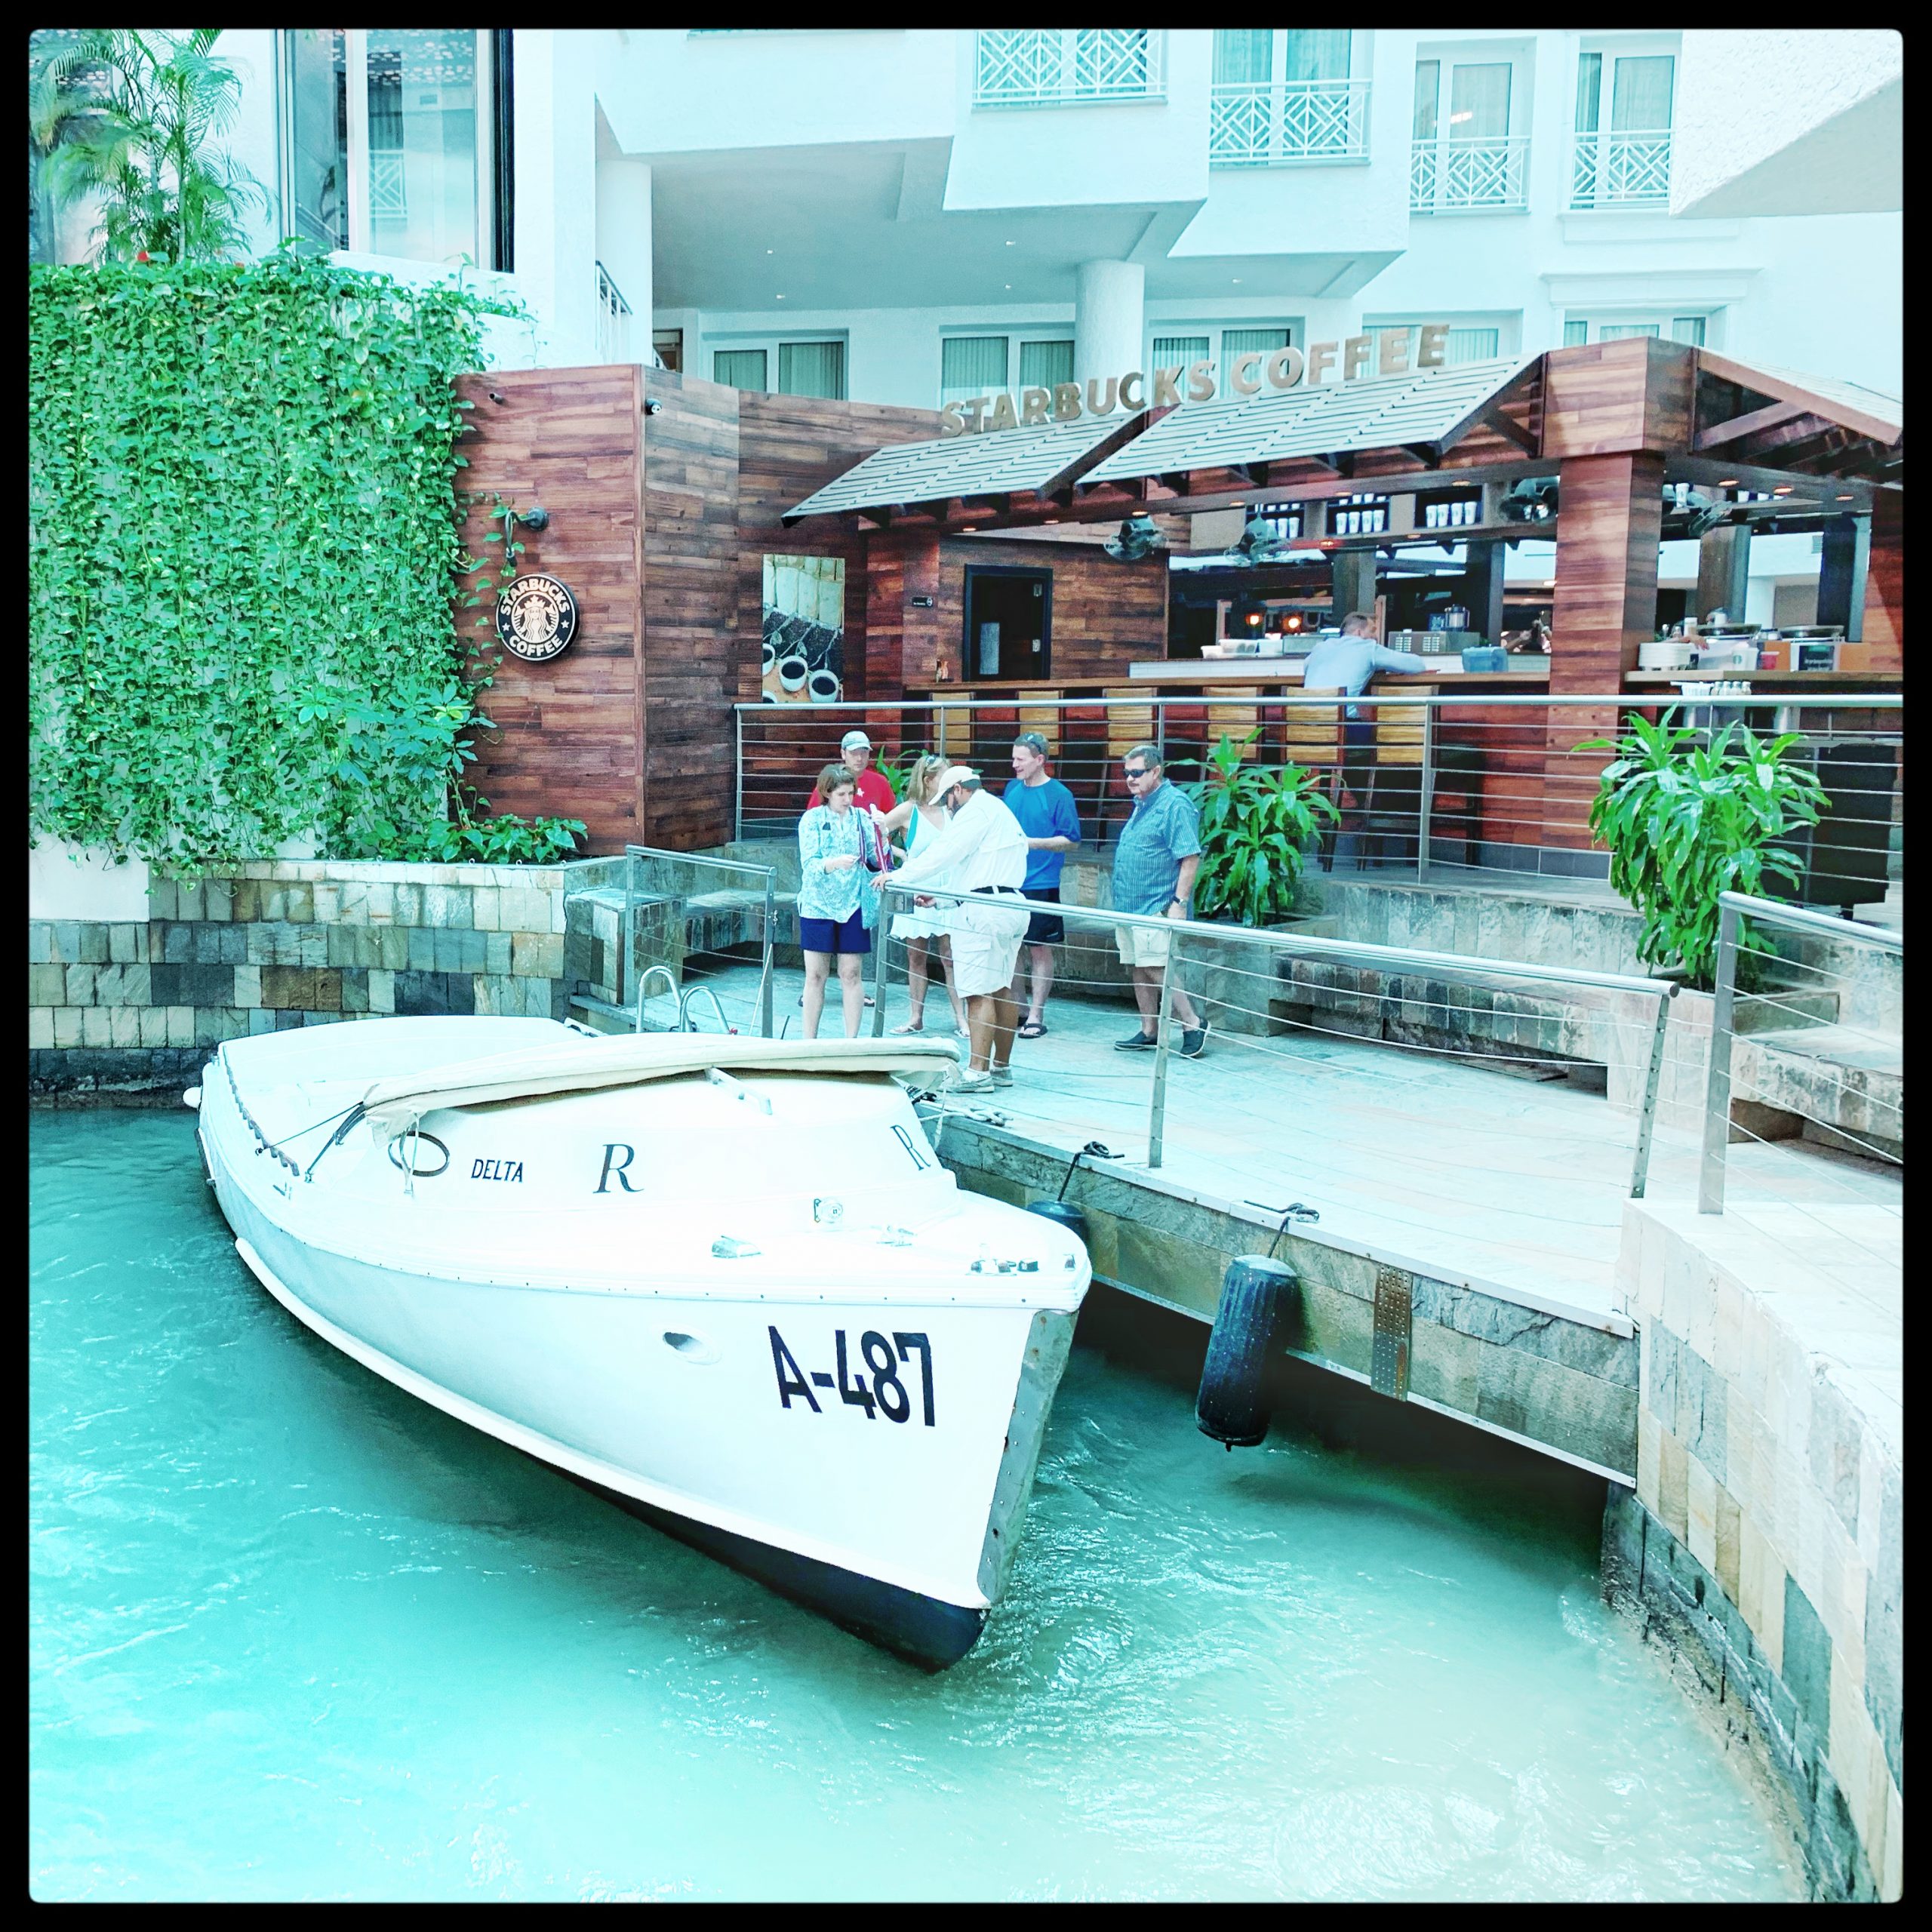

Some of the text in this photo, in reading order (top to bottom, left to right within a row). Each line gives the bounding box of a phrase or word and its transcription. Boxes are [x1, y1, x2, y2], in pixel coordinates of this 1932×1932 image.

[942, 325, 1450, 438] STARBUCKS COFFEE
[500, 578, 571, 616] STARBUCKS
[509, 635, 563, 657] COFFEE
[470, 1158, 523, 1183] DELTA
[592, 1143, 645, 1194] R
[890, 1124, 931, 1171] R
[768, 1325, 936, 1427] A-487
